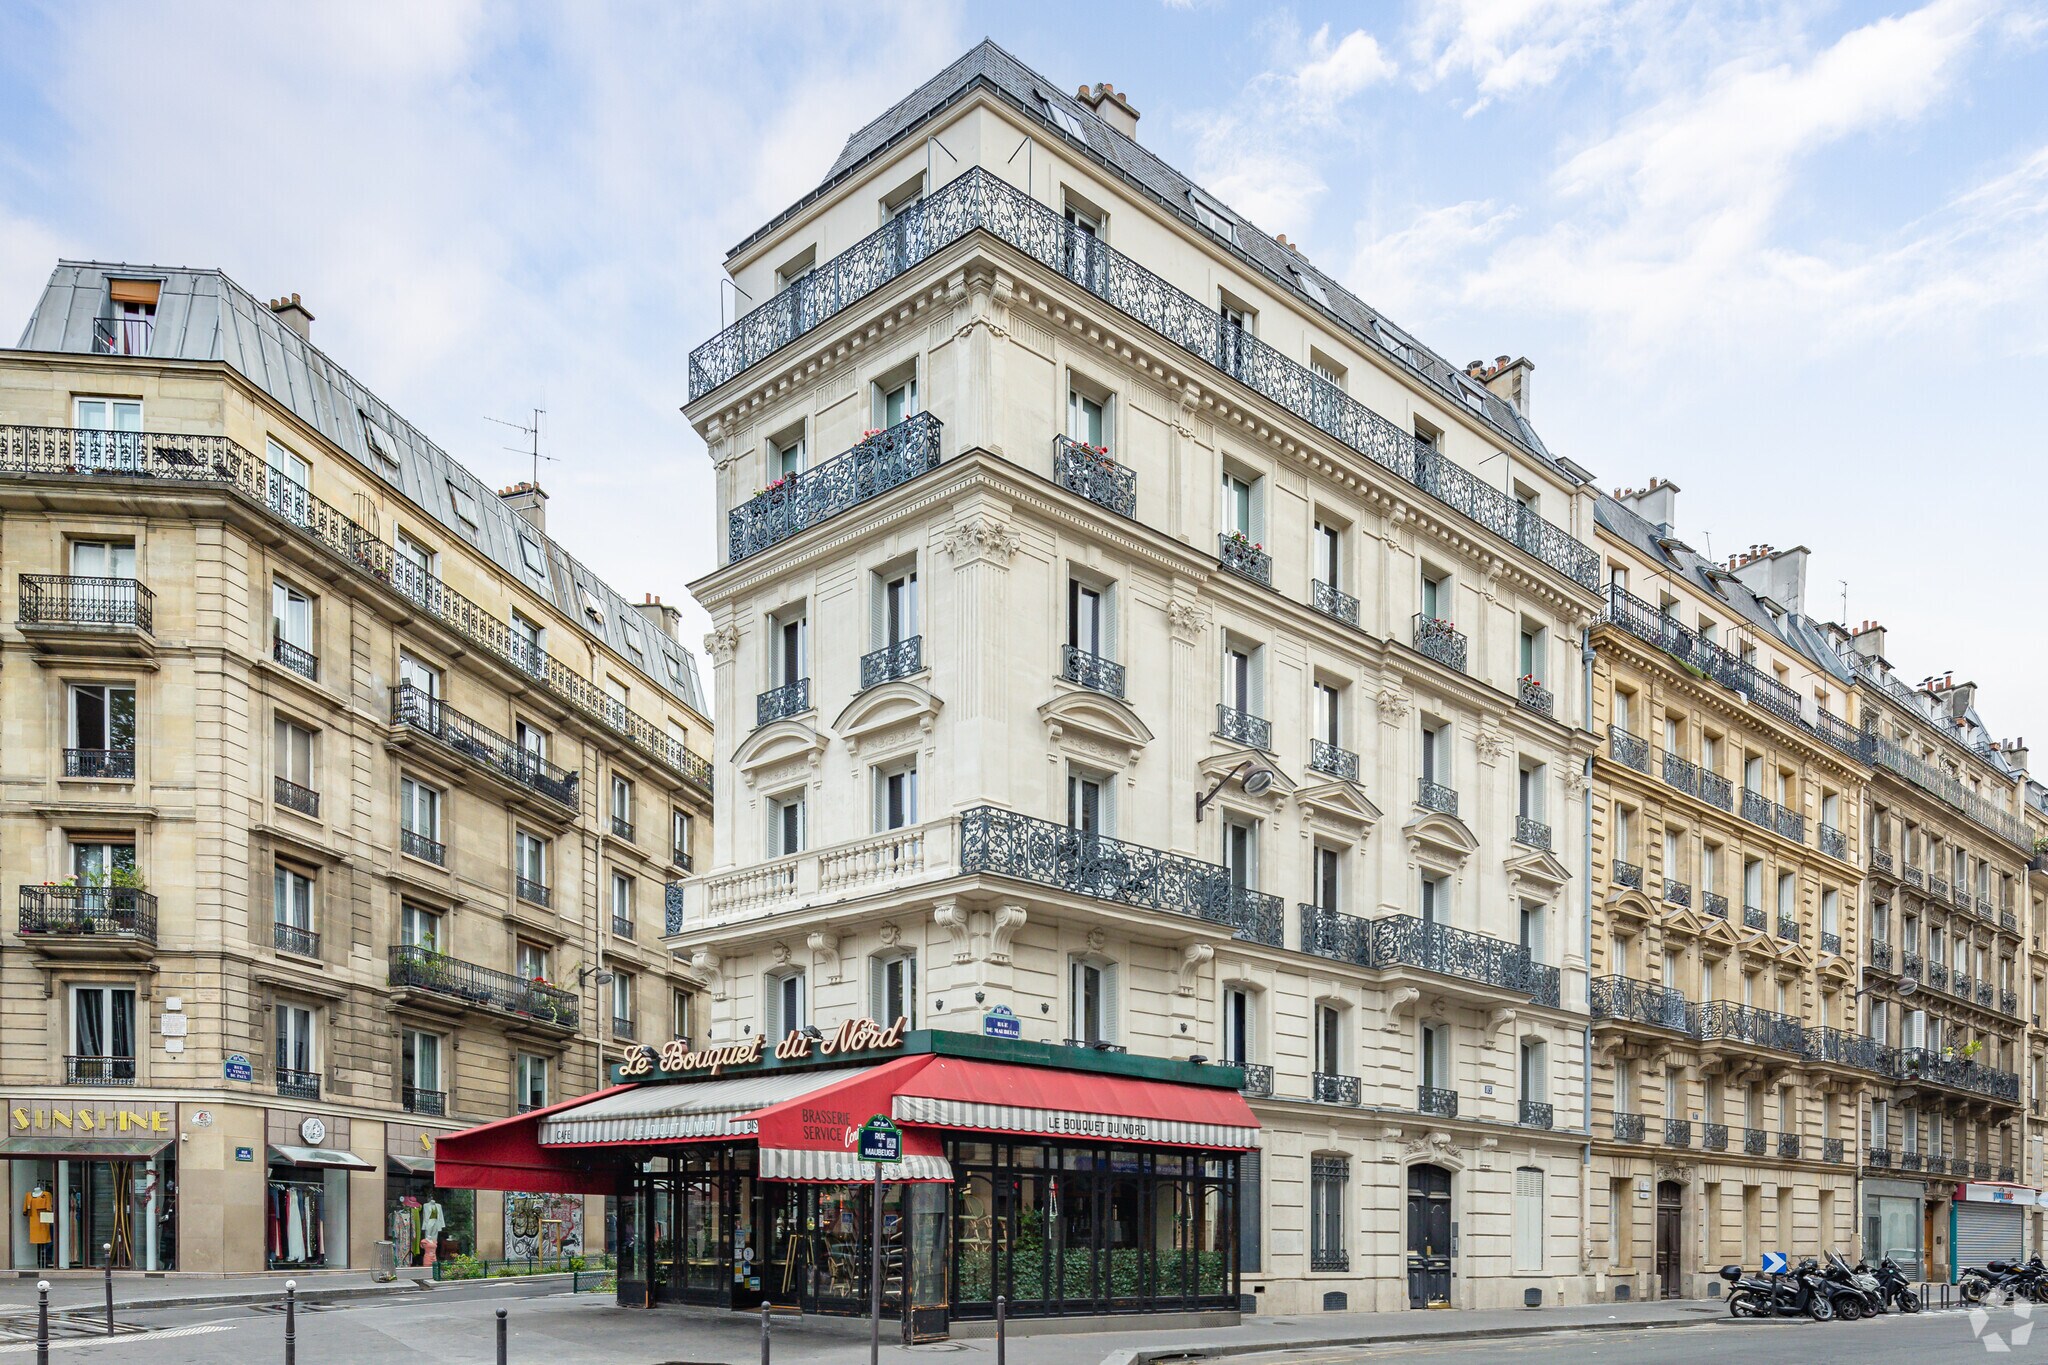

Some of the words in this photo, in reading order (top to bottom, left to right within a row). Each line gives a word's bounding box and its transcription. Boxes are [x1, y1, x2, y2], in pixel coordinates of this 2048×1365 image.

[619, 1044, 653, 1076] Le
[659, 1034, 766, 1076] Bouquet
[775, 1030, 813, 1060] du
[820, 1016, 907, 1056] Nord
[12, 1107, 169, 1132] SUNSHINE
[802, 1109, 851, 1126] BRASSERIE
[634, 1125, 644, 1136] LE
[645, 1123, 679, 1136] BOUQUET
[693, 1120, 716, 1133] NORD
[803, 1126, 843, 1141] SERVICE
[1048, 1117, 1060, 1129] LE
[1063, 1118, 1105, 1132] BOUQUET
[1107, 1122, 1119, 1133] DU
[1122, 1123, 1146, 1136] NORD
[874, 1132, 886, 1140] RUE
[865, 1148, 896, 1157] MAUBEUGE
